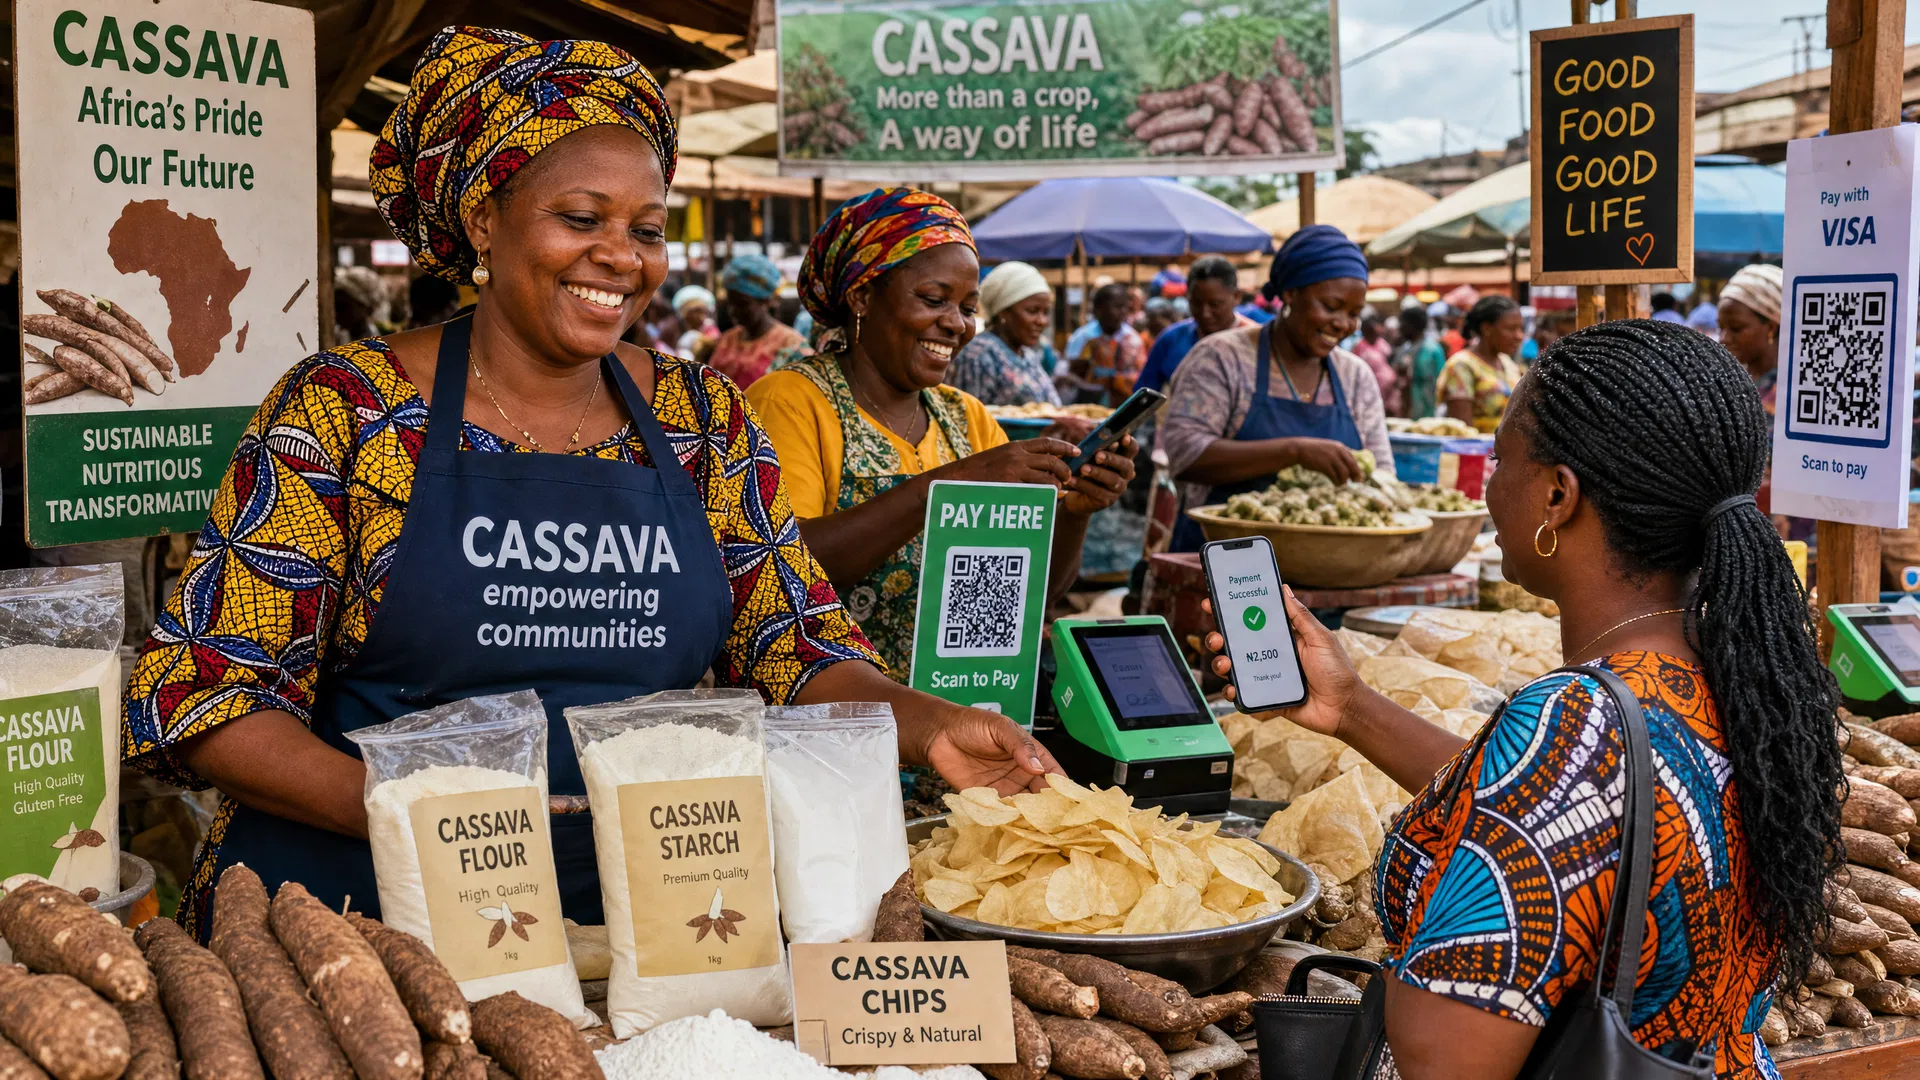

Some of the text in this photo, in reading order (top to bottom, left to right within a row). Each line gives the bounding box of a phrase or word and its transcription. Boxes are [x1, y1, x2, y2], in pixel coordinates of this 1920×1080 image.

[53, 9, 290, 89] CASSAVA
[872, 13, 1104, 77] CASSAVA
[1554, 55, 1655, 96] GOOD
[77, 86, 263, 137] Africa's Pride
[877, 83, 1099, 113] More than a crop,
[878, 113, 1098, 159] A way of life
[1559, 102, 1656, 145] FOOD
[93, 143, 255, 191] Our Future
[1556, 150, 1657, 192] GOOD
[1820, 186, 1869, 207] Pay with
[1566, 195, 1646, 237] LIFE
[1821, 215, 1877, 247] VISA
[83, 423, 213, 451] SUSTAINABLE
[82, 457, 202, 486] NUTRITIOUS
[1801, 454, 1868, 480] Scan to pay
[940, 503, 1044, 529] PAY HERE
[462, 516, 681, 573] CASSAVA
[1228, 573, 1262, 586] Payment
[1228, 586, 1269, 600] Successful
[483, 581, 660, 617] empowering
[477, 618, 667, 648] communities
[931, 669, 1020, 690] Scan to Pay
[1253, 674, 1270, 682] Thank
[7, 738, 74, 772] FLOUR
[13, 773, 85, 795] High Quality
[13, 793, 83, 815] Gluten Free
[649, 799, 741, 830] CASSAVA
[438, 808, 534, 844] CASSAVA
[459, 842, 528, 873] FLOUR
[660, 830, 740, 860] STARCH
[663, 867, 749, 885] Premium Quality
[458, 888, 490, 904] High
[504, 951, 518, 960] 1kg
[707, 955, 722, 964] 1kg
[831, 955, 970, 981] CASSAVA
[862, 988, 947, 1015] CHIPS
[842, 1024, 982, 1048] Crispy & Natural
